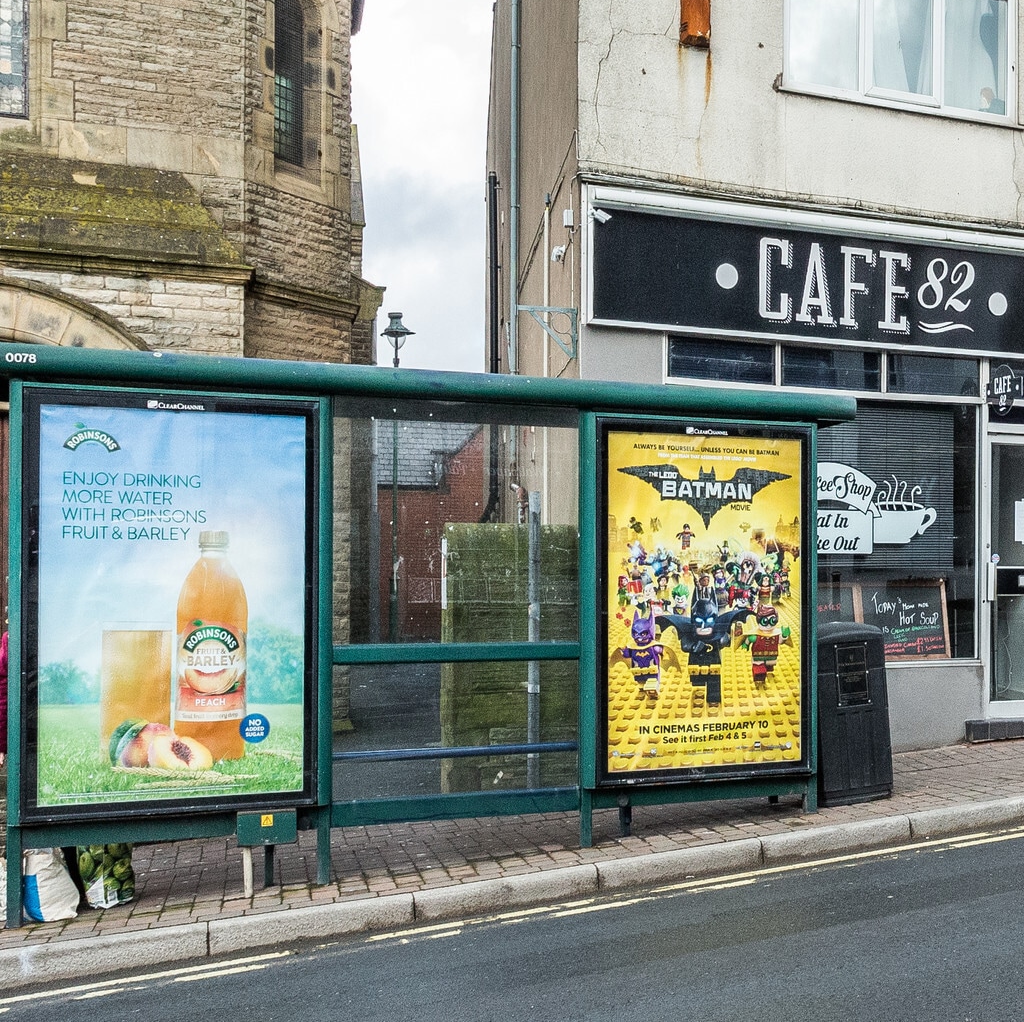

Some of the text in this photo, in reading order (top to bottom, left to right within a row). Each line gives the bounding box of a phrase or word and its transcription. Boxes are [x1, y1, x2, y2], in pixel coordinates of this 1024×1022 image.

[759, 236, 976, 335] CAFE 82
[5, 352, 37, 364] 0078
[994, 375, 1012, 395] CAFE
[67, 430, 118, 452] ROBINSONS
[63, 471, 201, 489] ENJOY DRINKING
[659, 470, 678, 479] LEGO
[662, 480, 752, 500] BATMAN
[833, 472, 872, 500] Shop
[62, 489, 173, 506] MORE WATER
[62, 507, 207, 524] WITH ROBINSONS
[834, 514, 849, 529] In
[62, 525, 190, 541] FRUIT & BARLEY
[834, 536, 860, 551] Out
[899, 611, 939, 626] HOT SOUP
[186, 628, 237, 650] ROBINSONS
[187, 655, 236, 667] BARLEY
[195, 698, 226, 707] PEACH
[248, 719, 261, 727] NO
[639, 720, 769, 734] IN CINEMAS FEBRUARY 10
[662, 731, 747, 744] See it first Feb 4 & 5
